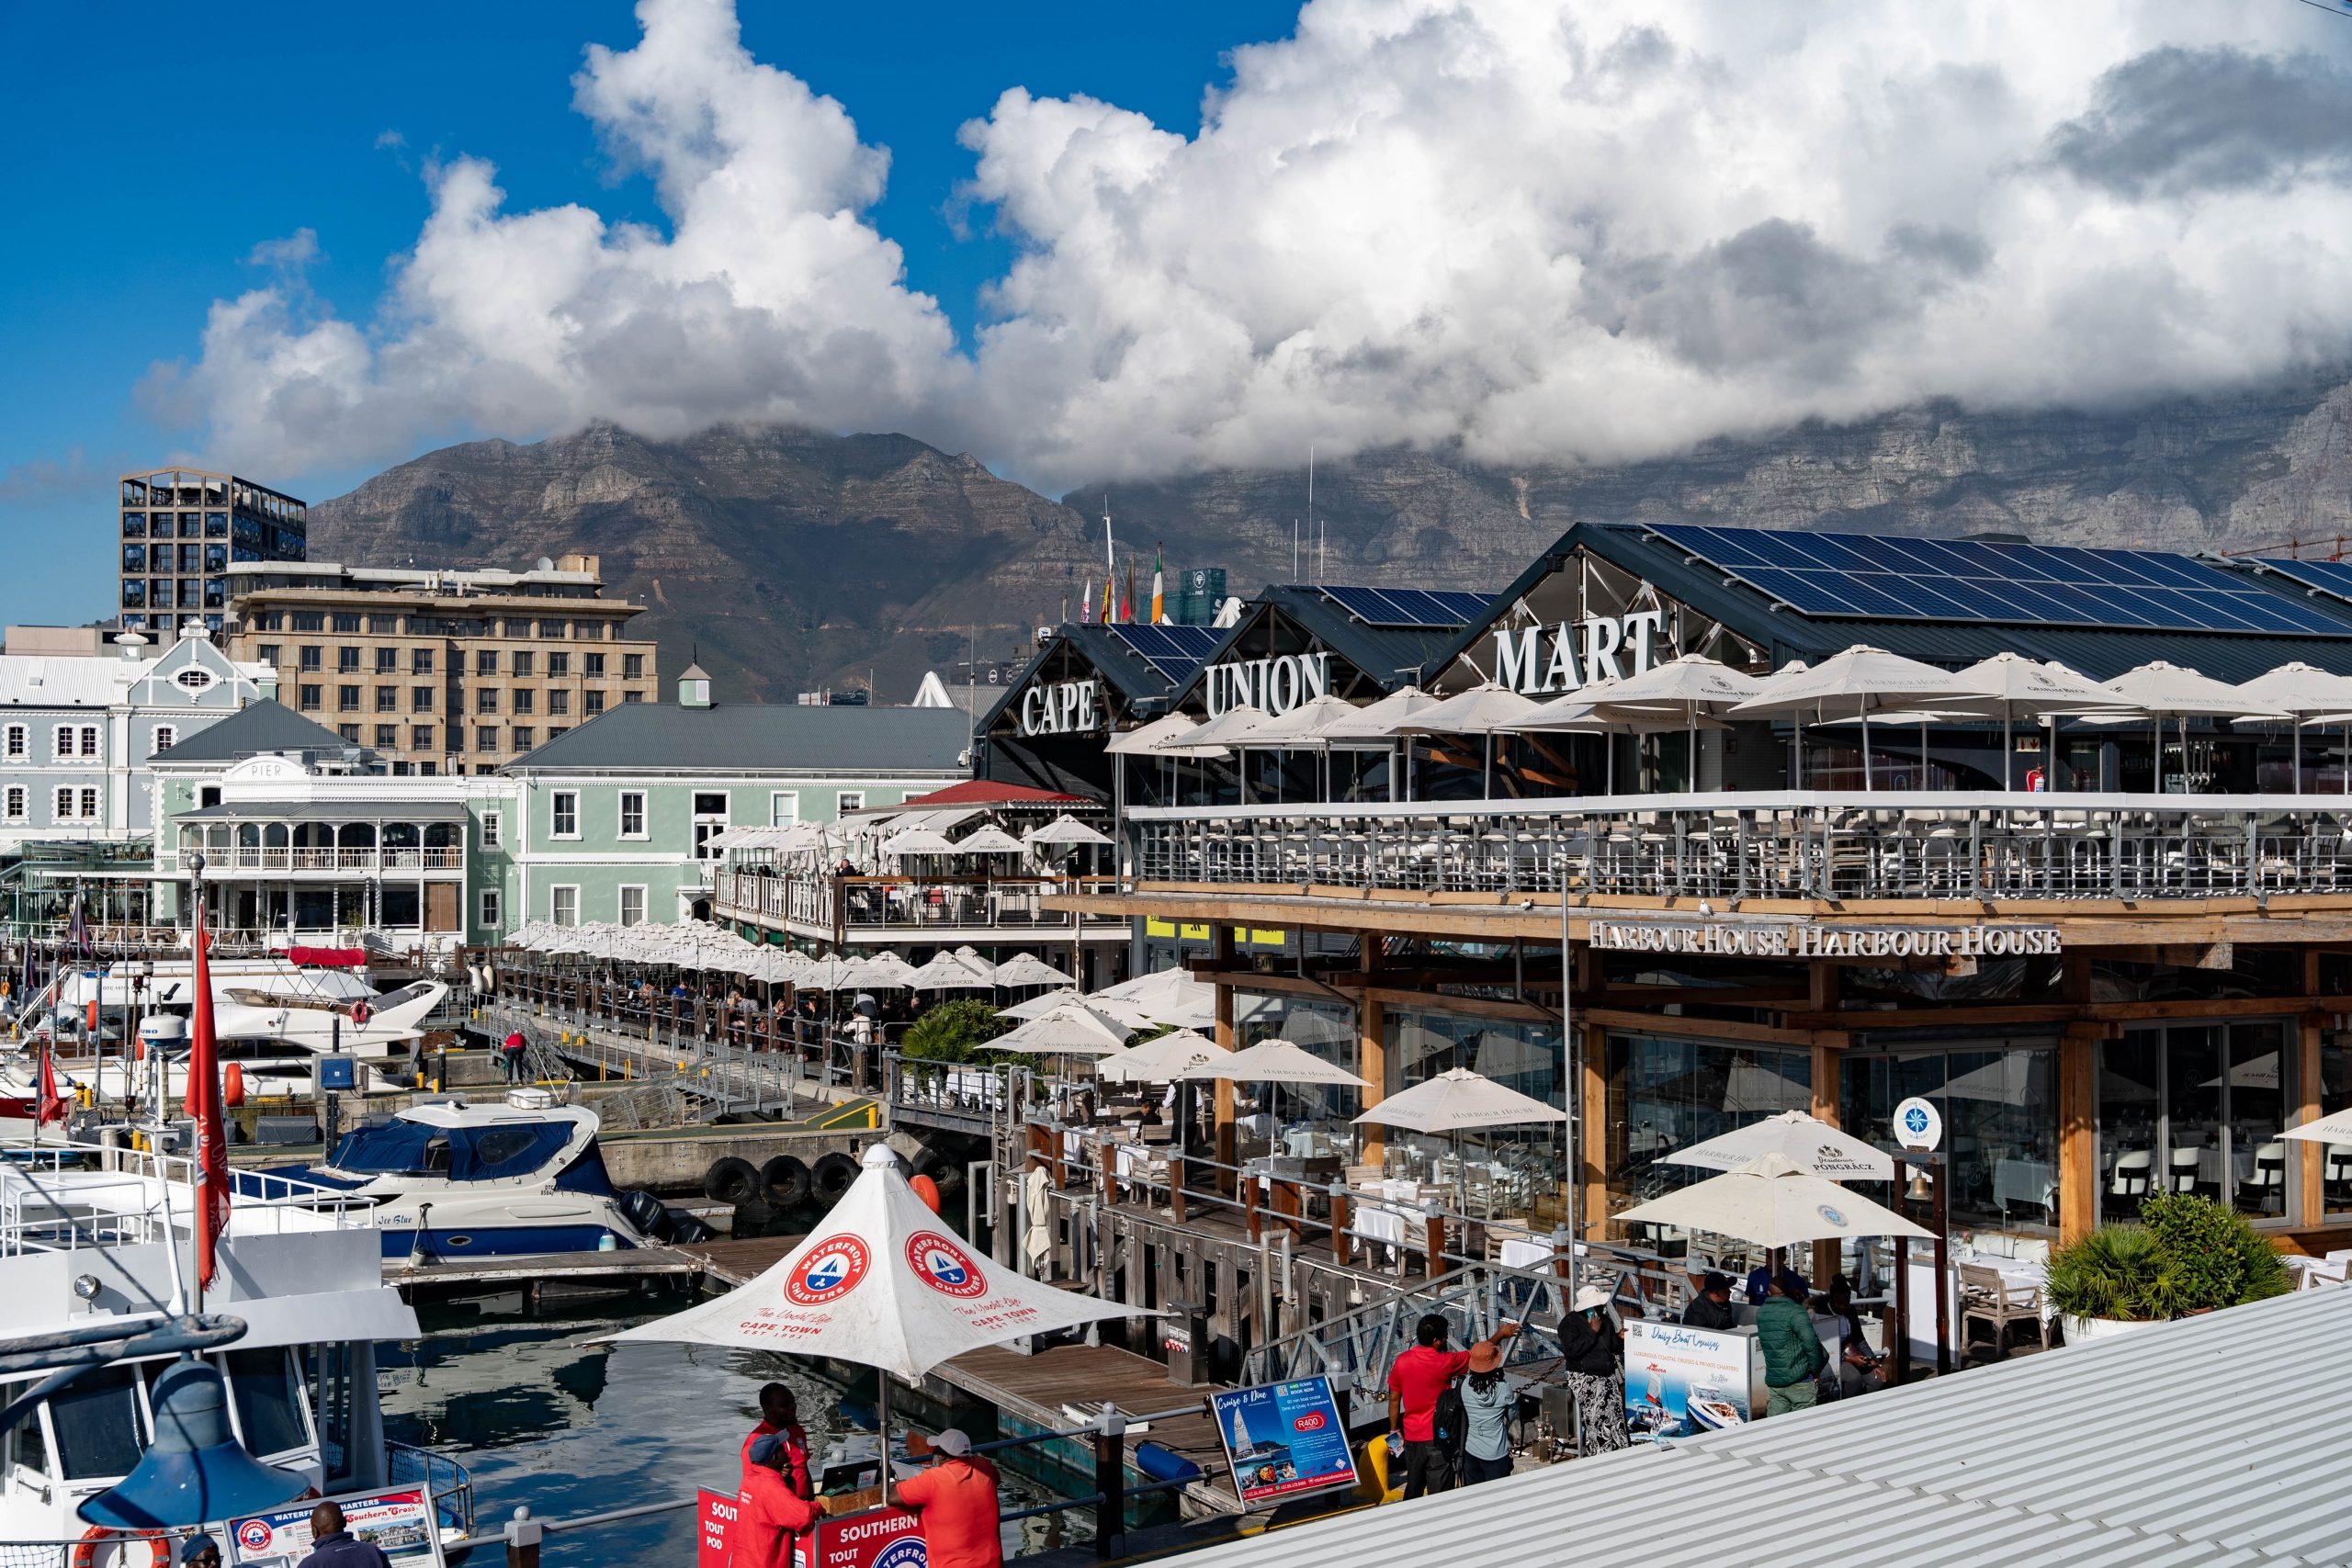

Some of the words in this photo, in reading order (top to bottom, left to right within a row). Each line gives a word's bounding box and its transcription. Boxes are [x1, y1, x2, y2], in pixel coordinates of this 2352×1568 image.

[1494, 610, 1670, 694] MART
[1204, 651, 1329, 717] UNION
[1022, 681, 1100, 737] CAPE
[252, 764, 281, 777] PIER
[1589, 921, 1702, 953] HARBOUR
[1703, 923, 1789, 957] HOUSE
[1796, 925, 1955, 957] HARBOUR
[1956, 924, 2062, 956] HOUSE
[1256, 957, 1272, 969] EXIT
[1307, 1070, 1339, 1078] HOUSE
[1452, 1110, 1500, 1120] HARBOUR
[1500, 1107, 1536, 1116] HOUSE
[1694, 1148, 1736, 1161] HARBOUR
[1736, 1154, 1752, 1164] HOU
[1812, 1160, 1876, 1171] PONGRÁCZ
[378, 1215, 391, 1224] Ice
[393, 1214, 413, 1224] Blue
[801, 1242, 863, 1274] WATERFRONT
[914, 1238, 967, 1271] WATERFRONT
[792, 1281, 844, 1302] CHARTERS
[935, 1275, 980, 1294] CHARTERS
[754, 1307, 775, 1318] The
[776, 1310, 810, 1322] Yacht
[954, 1305, 977, 1316] The
[974, 1300, 1003, 1314] Yacht
[971, 1315, 1003, 1327] CAPE
[1002, 1307, 1037, 1319] TOWN
[740, 1322, 778, 1331] CAPE
[782, 1325, 823, 1335] TOWN
[1651, 1326, 1671, 1345] Daily
[1672, 1329, 1691, 1347] Boat
[1691, 1334, 1721, 1352] Cruises
[1634, 1351, 1657, 1359] LUXURIOUS
[1657, 1354, 1676, 1362] COASTAL
[1677, 1358, 1694, 1366] CRUISES
[1699, 1360, 1716, 1369] PRIVATE
[1716, 1363, 1739, 1372] CHARTERS
[1217, 1397, 1241, 1410] Cruise
[1243, 1394, 1248, 1404] &
[1250, 1390, 1267, 1403] Dine
[1297, 1417, 1318, 1427] R400
[339, 1498, 379, 1511] HARTERS
[388, 1506, 416, 1516] Cross
[712, 1501, 738, 1522] SOUT
[274, 1509, 314, 1521] WATERF
[242, 1523, 269, 1538] WATERFRONT
[705, 1520, 724, 1536] TOUT
[840, 1514, 918, 1543] SOUTHERN
[244, 1539, 269, 1550] CHARTERS
[707, 1536, 723, 1550] POD
[829, 1548, 859, 1564] TOUT
